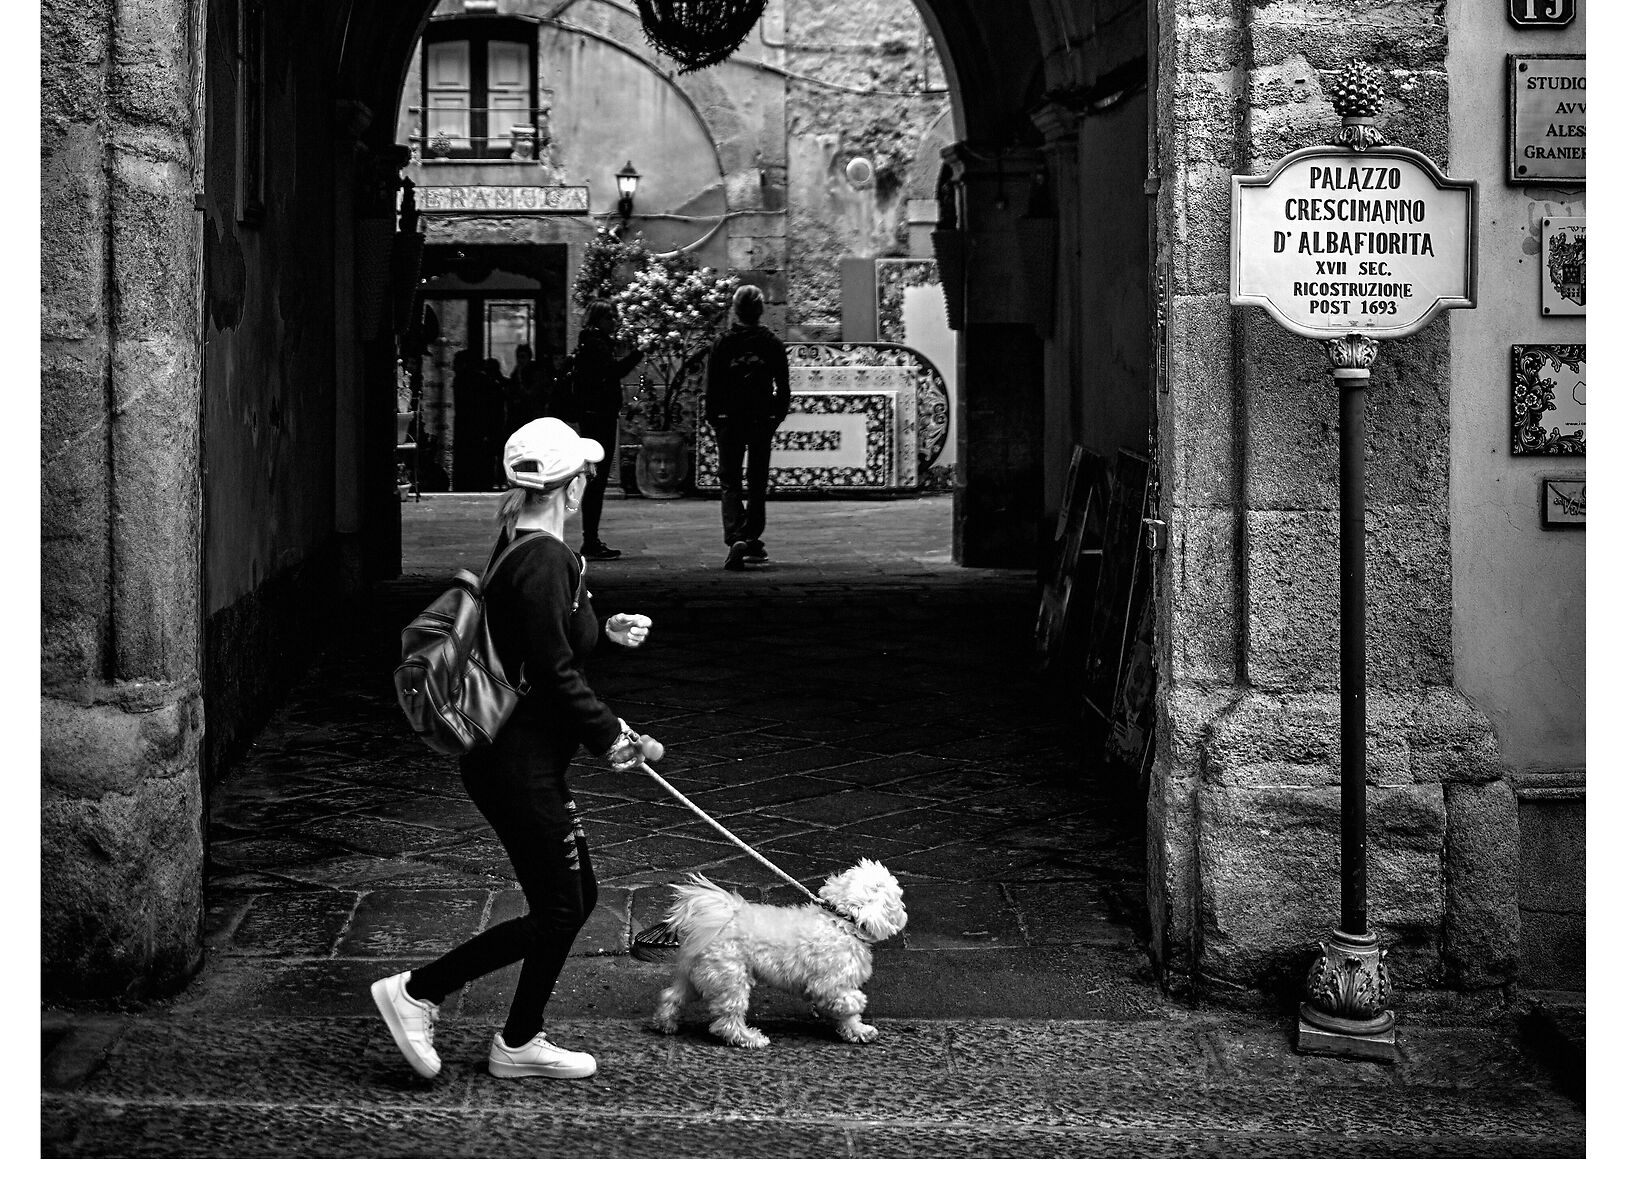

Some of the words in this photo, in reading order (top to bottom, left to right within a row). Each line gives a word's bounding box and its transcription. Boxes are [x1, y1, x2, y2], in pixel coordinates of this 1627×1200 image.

[1546, 123, 1586, 138] ALES
[1309, 166, 1401, 192] PALAZZO
[1285, 198, 1425, 225] CRESCIMANNO
[1298, 231, 1435, 257] ALBAFIORITA
[1315, 260, 1347, 276] XVII
[1358, 261, 1392, 277] SEC.
[1293, 282, 1413, 299] RICOSTRUZIONE
[1309, 300, 1351, 315] POST
[1360, 300, 1397, 315] 1693
